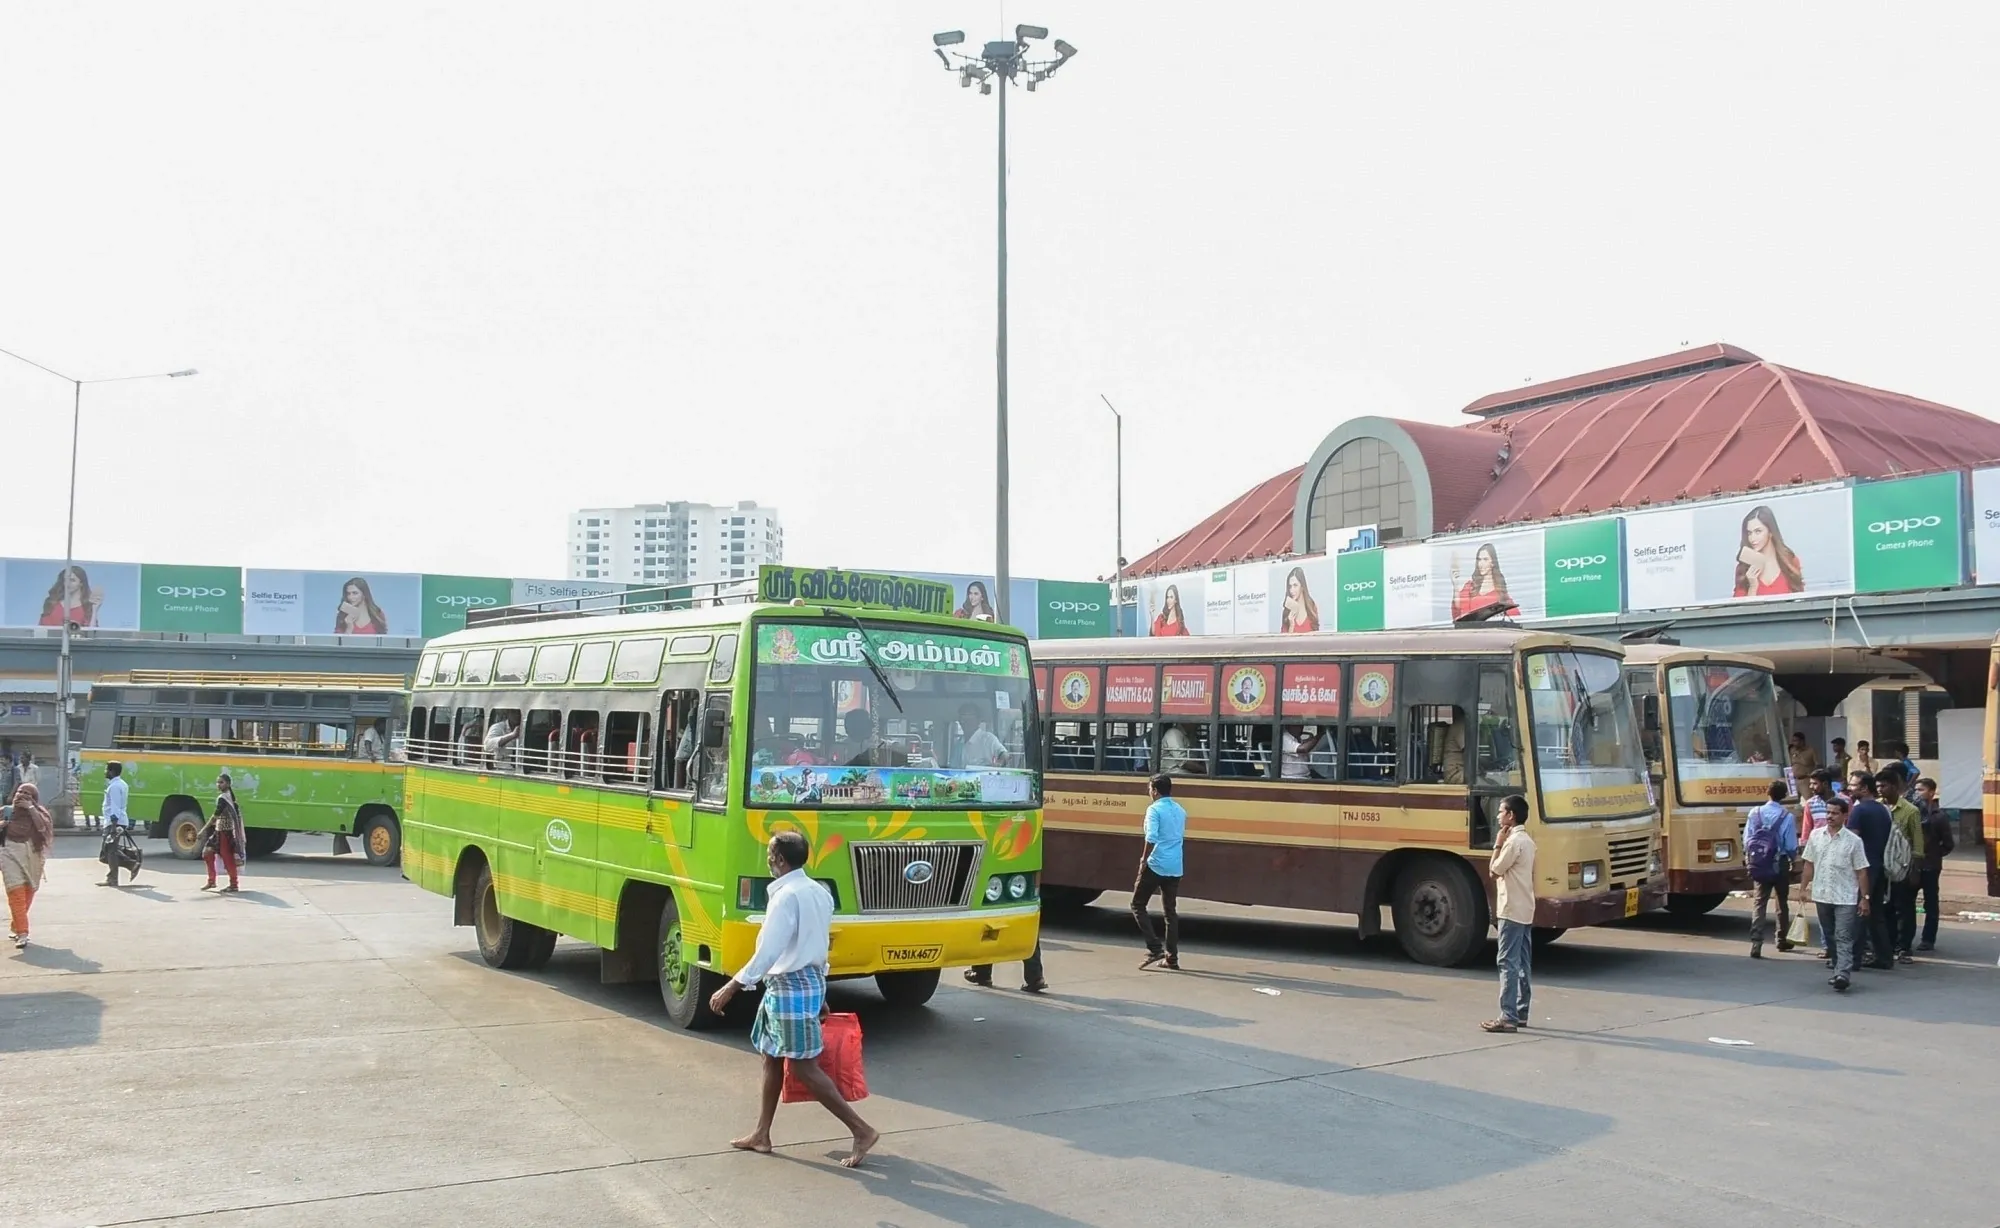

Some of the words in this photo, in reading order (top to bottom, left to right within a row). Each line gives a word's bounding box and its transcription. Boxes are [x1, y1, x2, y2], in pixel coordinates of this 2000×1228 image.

[1868, 515, 1942, 535] oppo
[1633, 548, 1657, 557] Selfie
[1658, 543, 1687, 555] Expert
[1875, 542, 1906, 551] Camera
[1907, 539, 1934, 549] Phone
[1554, 554, 1607, 570] oppo
[1389, 576, 1406, 585] Selfie
[1407, 574, 1427, 583] Expert
[156, 584, 227, 599] oppo
[550, 586, 578, 597] Selfie
[1343, 580, 1377, 592] oppo
[251, 591, 273, 600] Selfie
[273, 592, 298, 601] Expert
[435, 595, 498, 607] oppo
[163, 603, 194, 613] Camera
[194, 604, 220, 614] Phone
[1049, 601, 1101, 613] oppo
[1054, 617, 1077, 625] Camera
[878, 640, 1001, 667] அம்மன்
[1106, 686, 1137, 703] VASANTH
[1142, 687, 1153, 704] CO
[1171, 679, 1205, 699] VASANTH
[1062, 796, 1088, 807] கழகம்
[1343, 811, 1359, 821] TNJ
[1360, 812, 1381, 822] 0583
